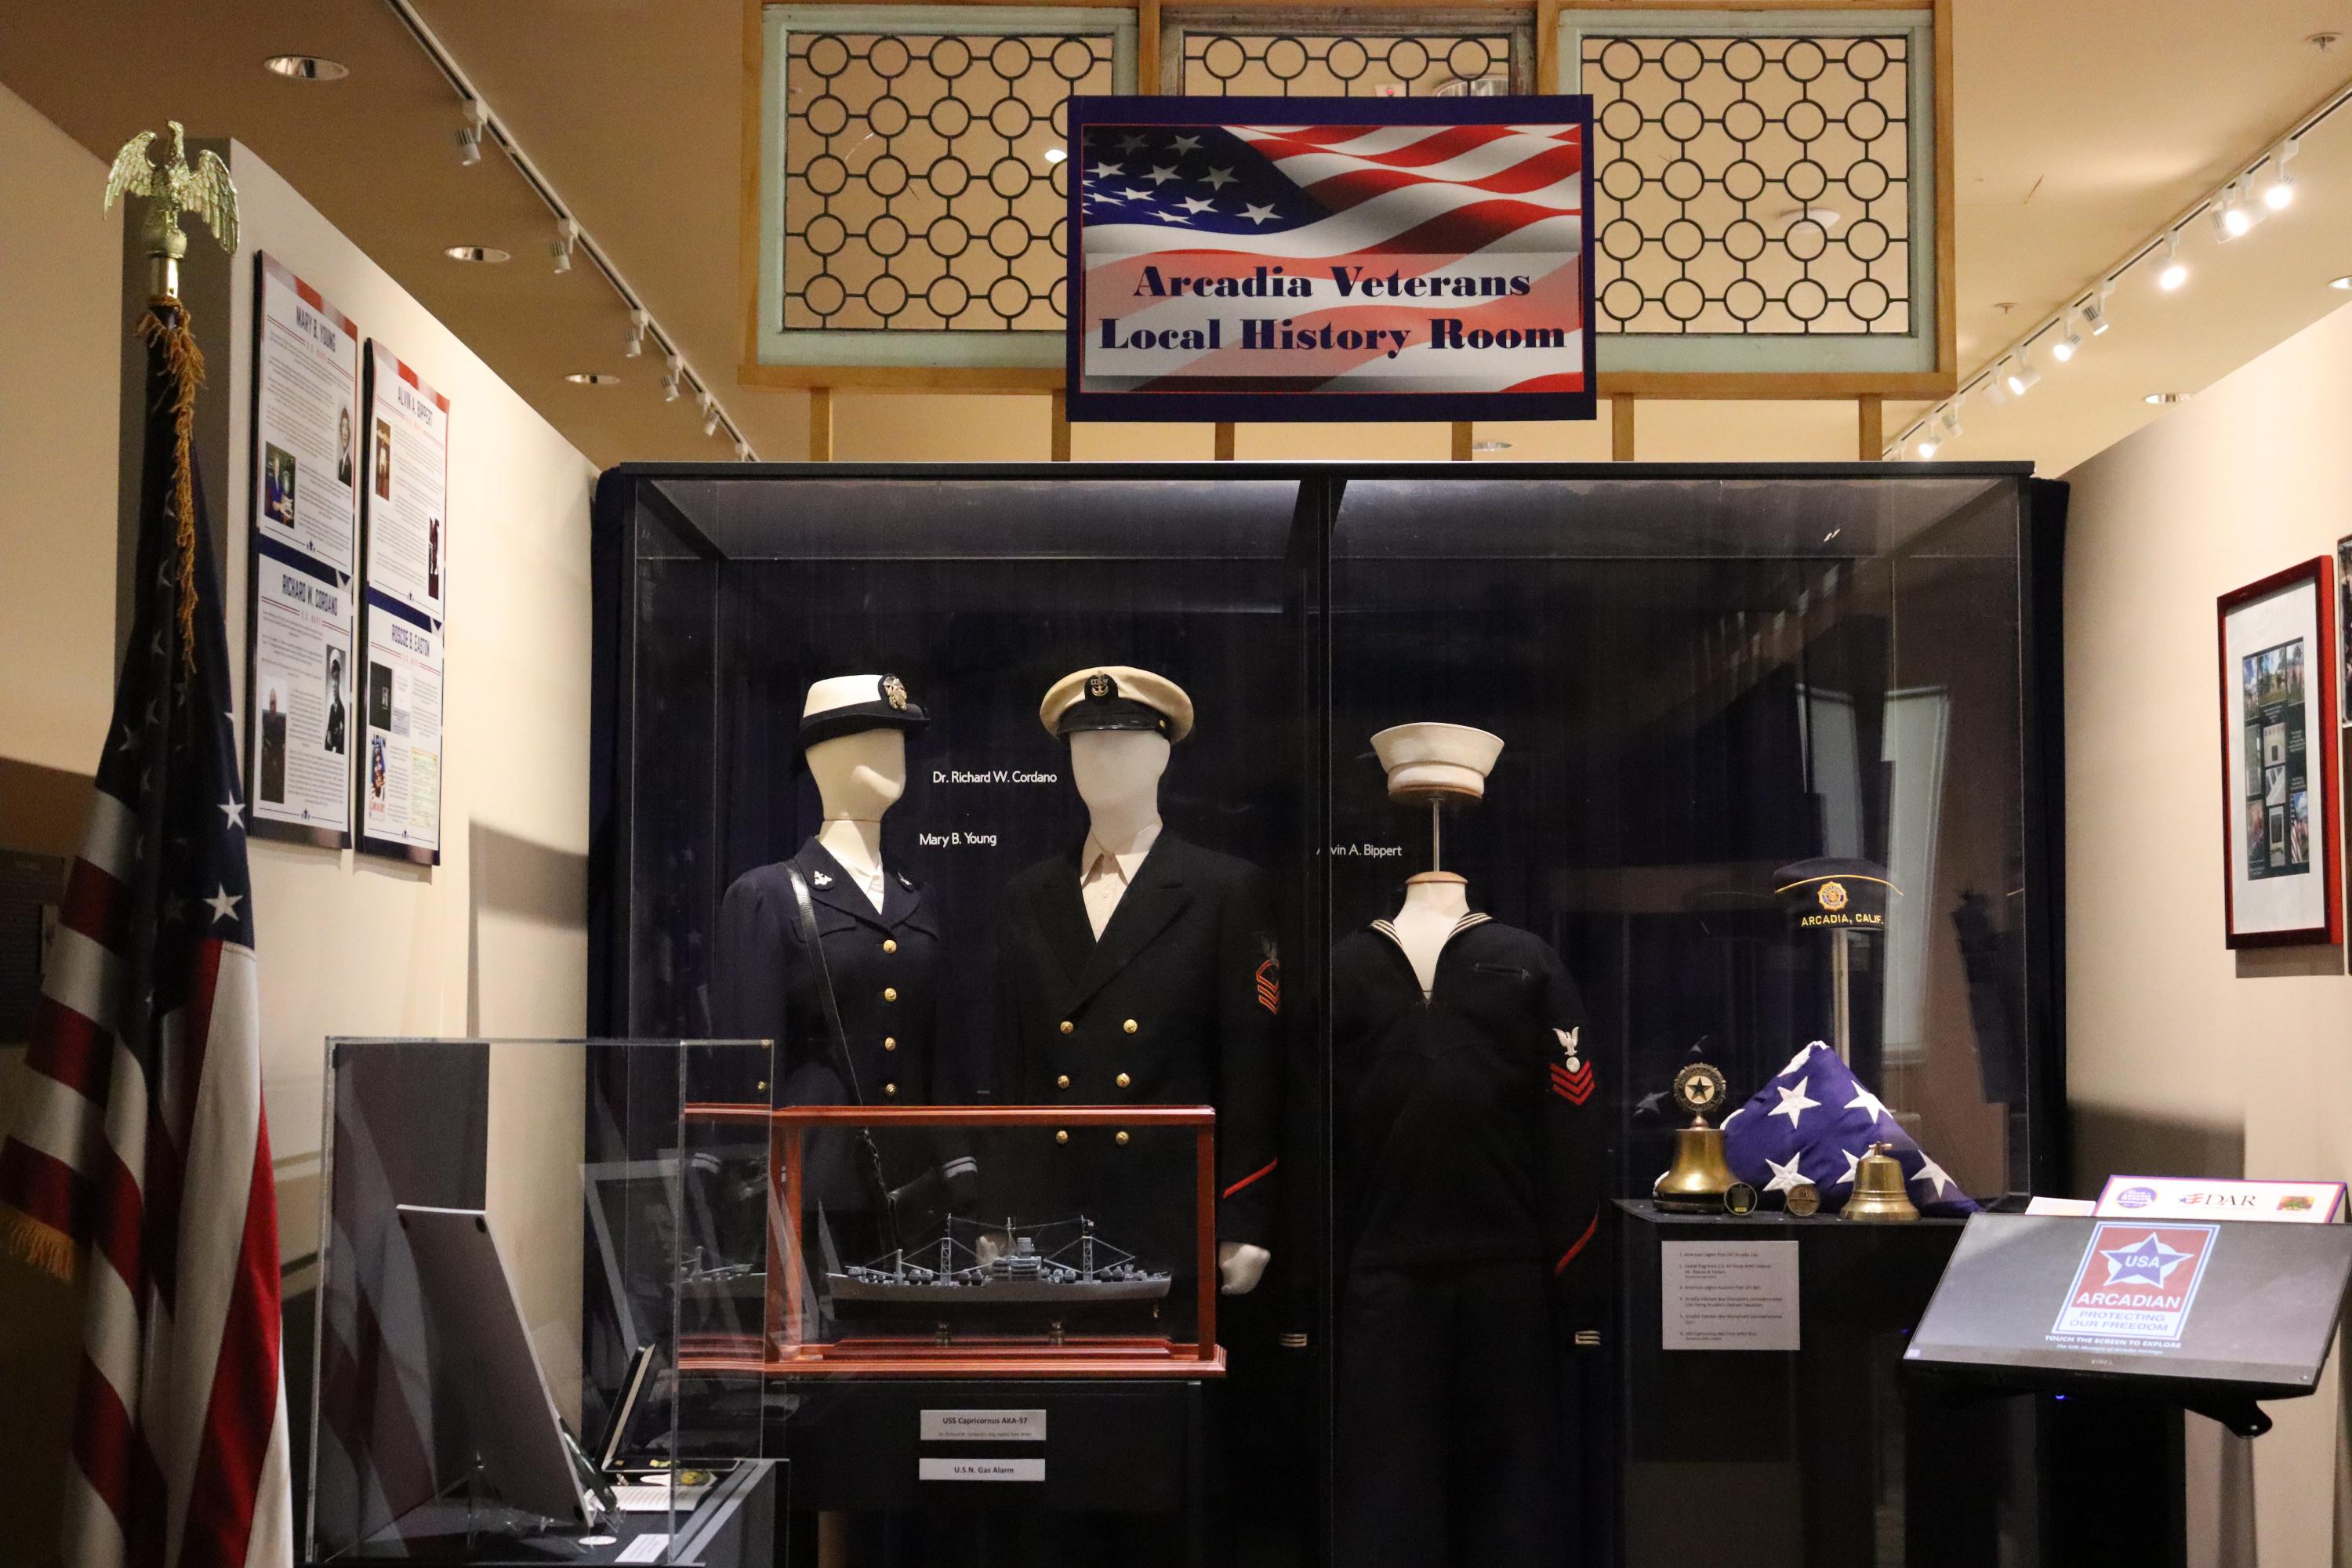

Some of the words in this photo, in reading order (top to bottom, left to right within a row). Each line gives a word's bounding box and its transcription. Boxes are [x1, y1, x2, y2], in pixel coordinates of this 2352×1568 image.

[1132, 266, 1313, 297] Arcadia
[1330, 266, 1531, 297] Veterans
[296, 306, 312, 335] MARY
[320, 323, 336, 352] YOUNG
[1098, 318, 1223, 350] Local
[1239, 318, 1411, 359] History
[1428, 318, 1567, 350] Room
[282, 574, 306, 603] RICHARD
[315, 589, 338, 617] CORDANO
[932, 771, 949, 783] Dr.
[951, 771, 991, 783] Richard
[993, 771, 1010, 783] W.
[1011, 771, 1058, 783] Cordano
[919, 833, 949, 848] Mary
[951, 832, 962, 845] B.
[964, 831, 997, 847] Young
[1348, 844, 1362, 855] A.
[1363, 844, 1403, 858] Bippert
[1801, 913, 1853, 927] ARCADIA,
[1855, 913, 1884, 924] CALIF.
[2205, 1193, 2256, 1206] DAR
[2125, 1255, 2161, 1268] USA
[2075, 1292, 2181, 1308] ARCADIAN
[2079, 1311, 2165, 1322] PROTECTING
[2070, 1319, 2098, 1328] OUR
[2101, 1321, 2169, 1331] FREEDOM
[958, 1417, 1000, 1425] Capricornus
